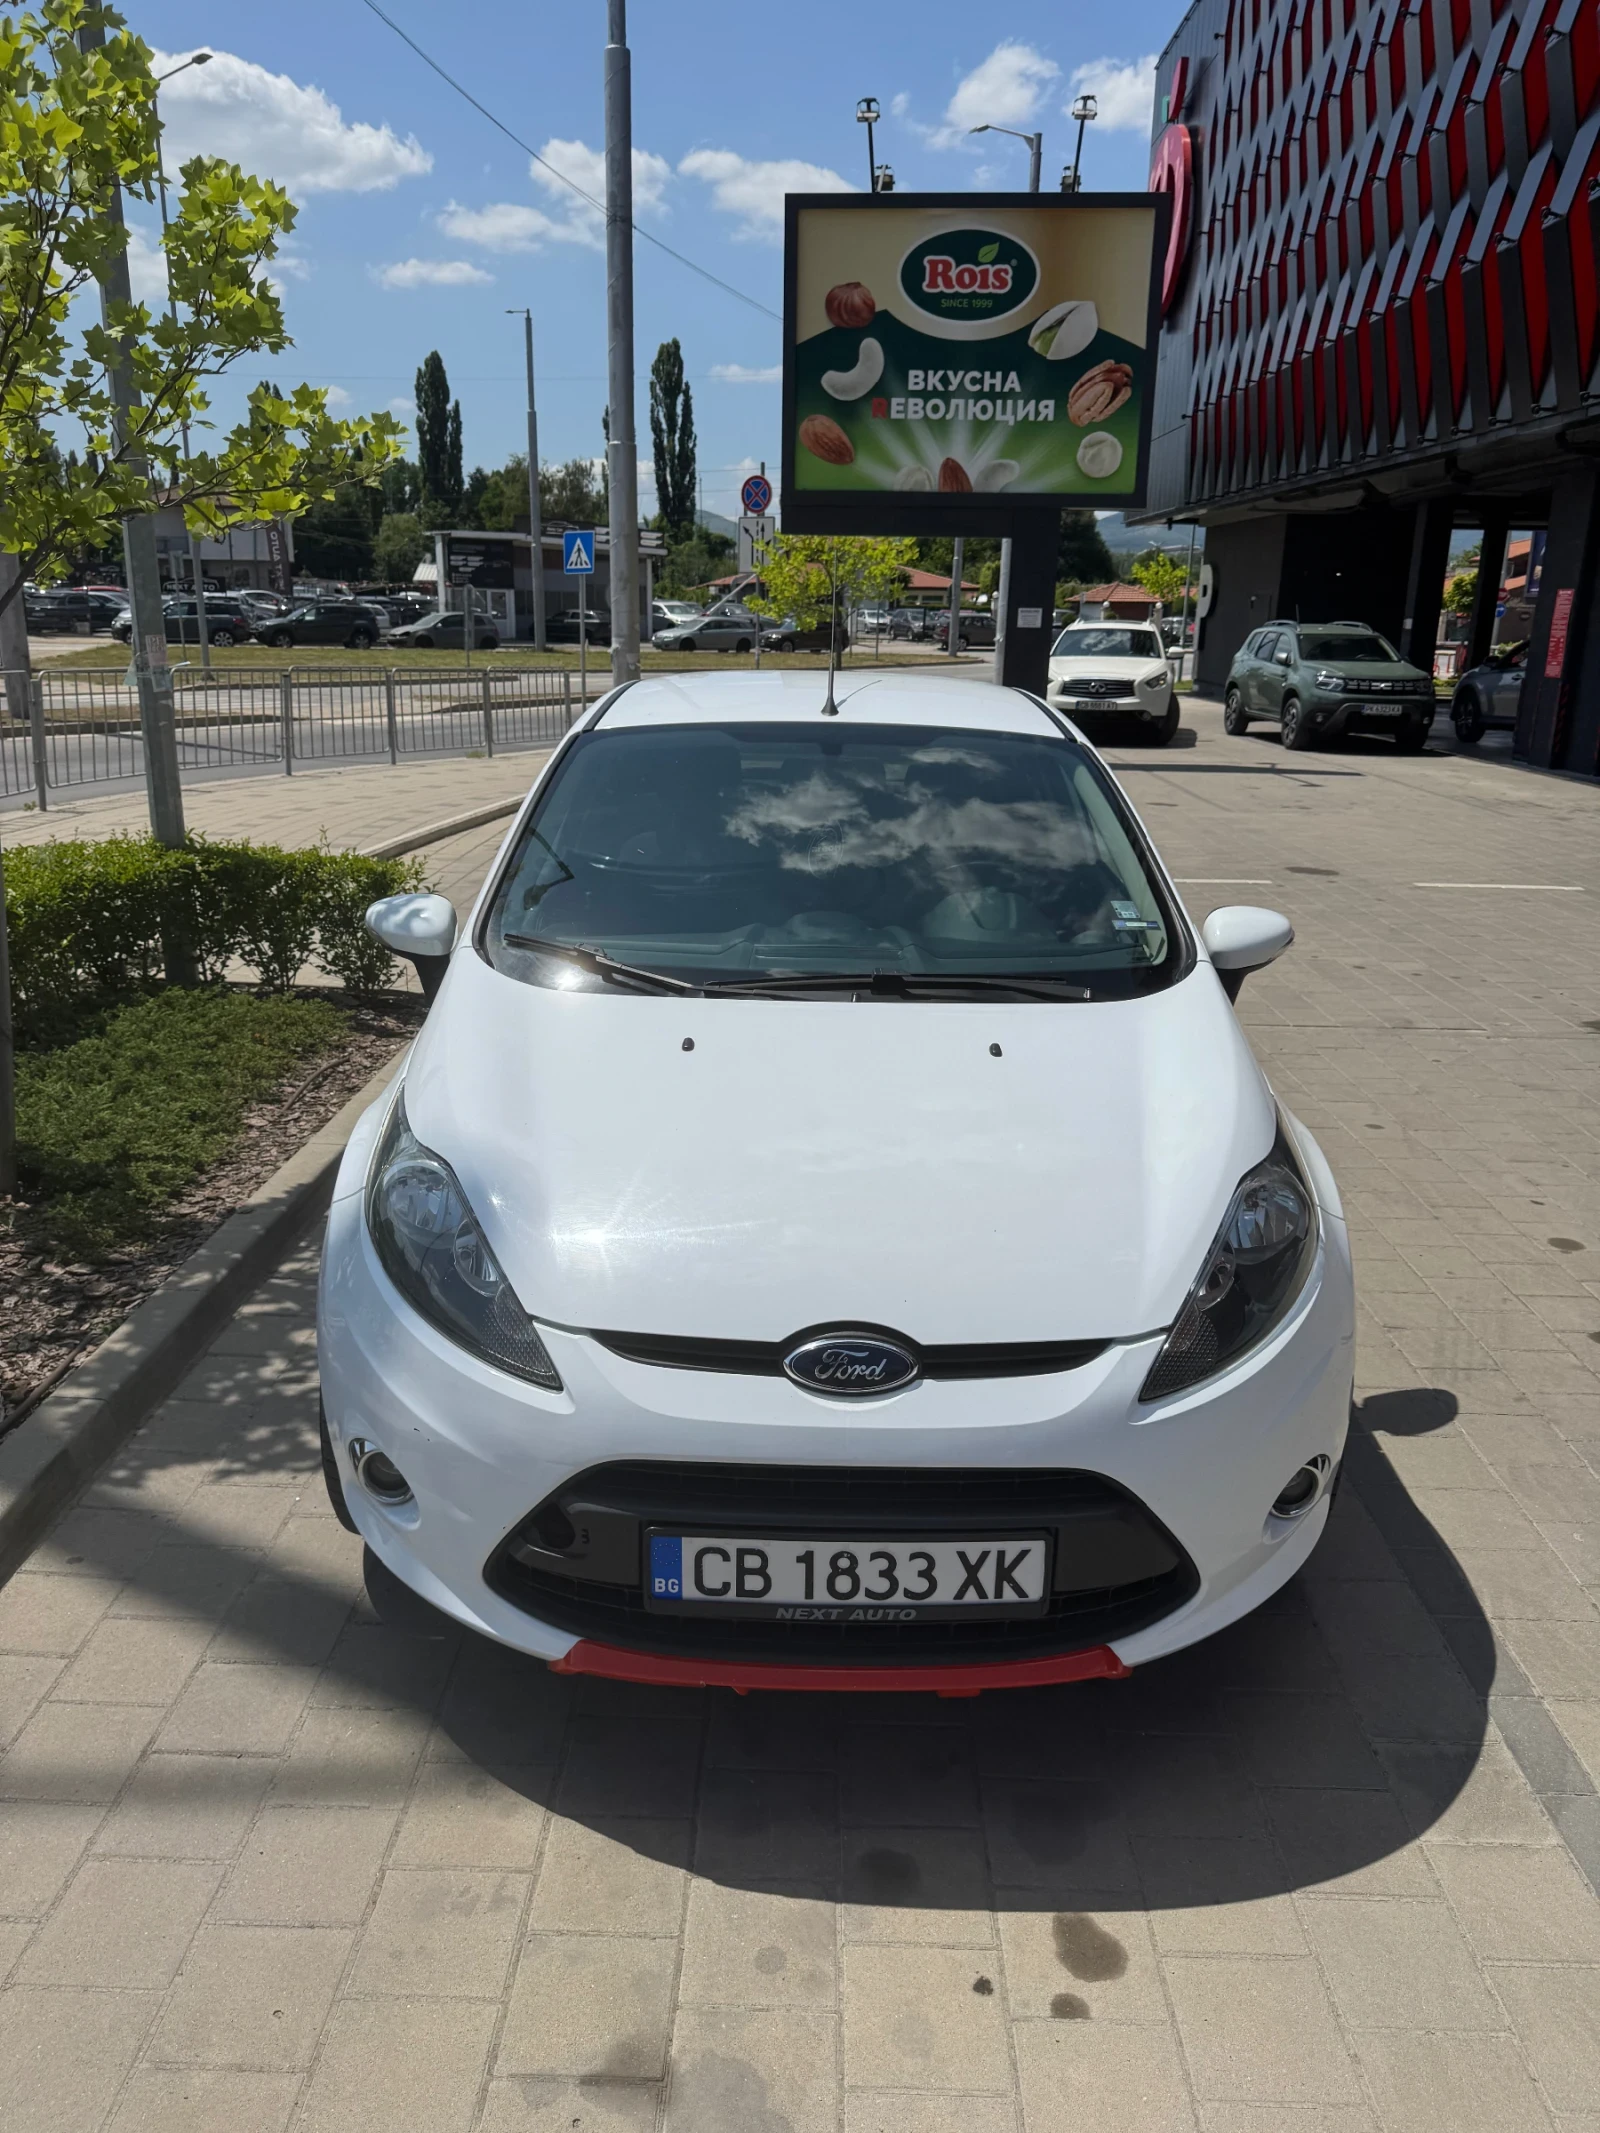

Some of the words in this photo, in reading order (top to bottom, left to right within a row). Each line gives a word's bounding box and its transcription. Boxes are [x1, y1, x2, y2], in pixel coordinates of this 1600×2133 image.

[923, 257, 1011, 291] Rois
[941, 299, 969, 308] SINCE
[972, 299, 993, 308] 1999
[908, 369, 1022, 392] ВКУСНА
[871, 397, 1056, 426] RЕВОЛЮЦИЯ
[814, 1349, 888, 1380] Ford
[653, 1577, 680, 1594] BG
[693, 1546, 773, 1599] CB
[795, 1550, 939, 1601] 1833
[952, 1548, 1033, 1600] XK
[775, 1607, 843, 1620] NEXT
[848, 1607, 918, 1621] AUTO
